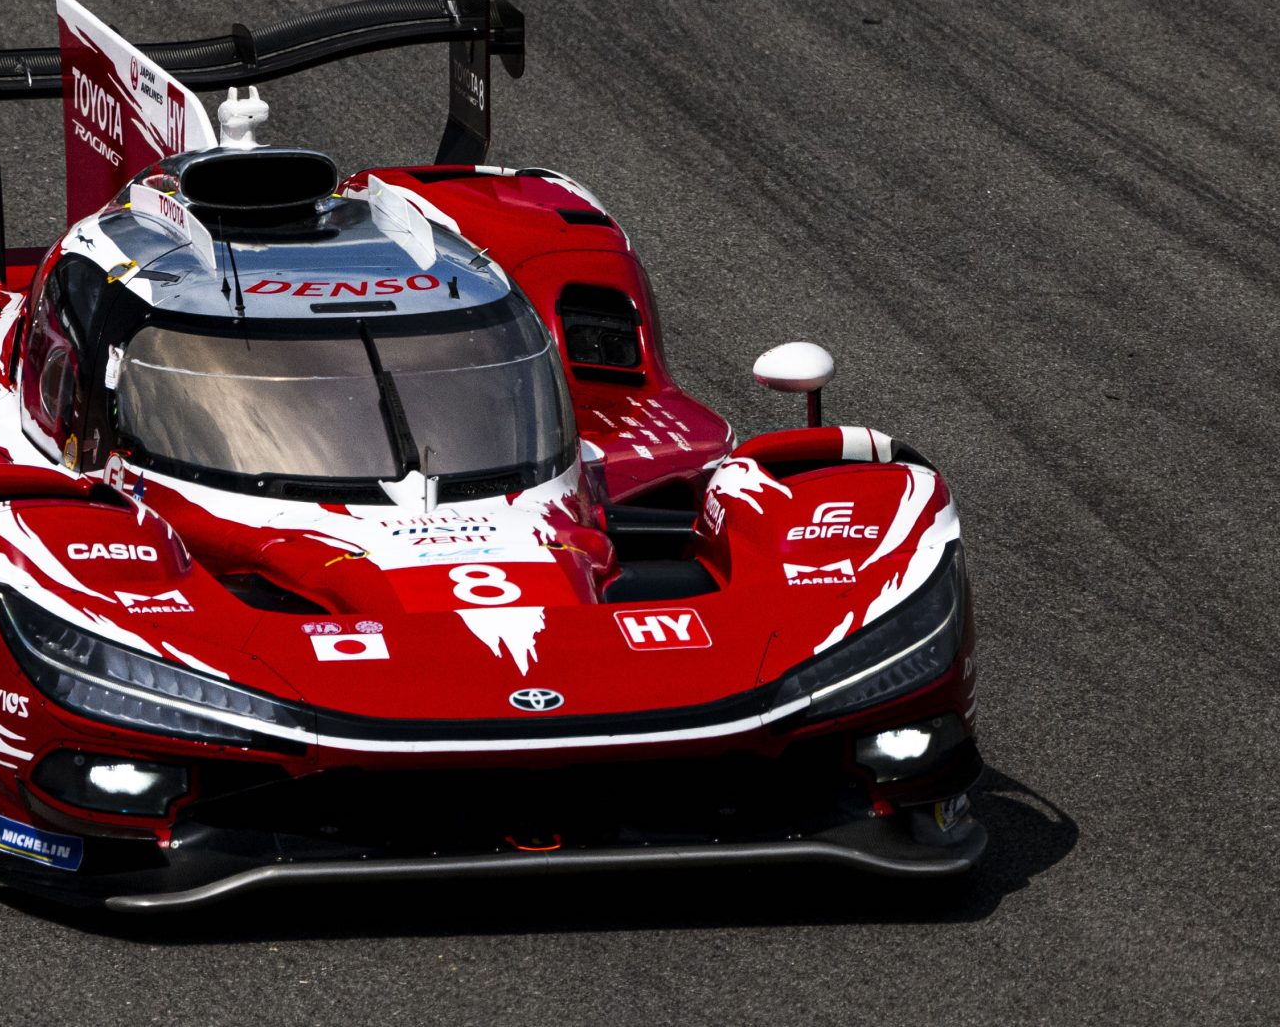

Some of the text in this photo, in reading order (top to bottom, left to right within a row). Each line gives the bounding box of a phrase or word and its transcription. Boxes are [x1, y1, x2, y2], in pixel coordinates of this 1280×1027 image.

[140, 65, 156, 84] JAPAN
[71, 65, 123, 146] TOYOTA
[140, 82, 164, 105] AIRLINES
[479, 78, 485, 112] 8
[168, 96, 185, 153] HY
[71, 118, 124, 168] RACING
[158, 194, 185, 228] TOYOTA
[243, 274, 440, 297] DENSO
[715, 507, 726, 535] 8
[786, 525, 880, 541] EDIFICE
[67, 543, 158, 562] CASIO
[407, 534, 492, 546] ZENT
[448, 563, 522, 606] 8
[787, 576, 857, 586] MARELLI
[127, 606, 195, 614] MARELLI
[302, 623, 341, 634] FIA
[623, 614, 692, 643] HY
[1, 828, 71, 859] MICHELIN
